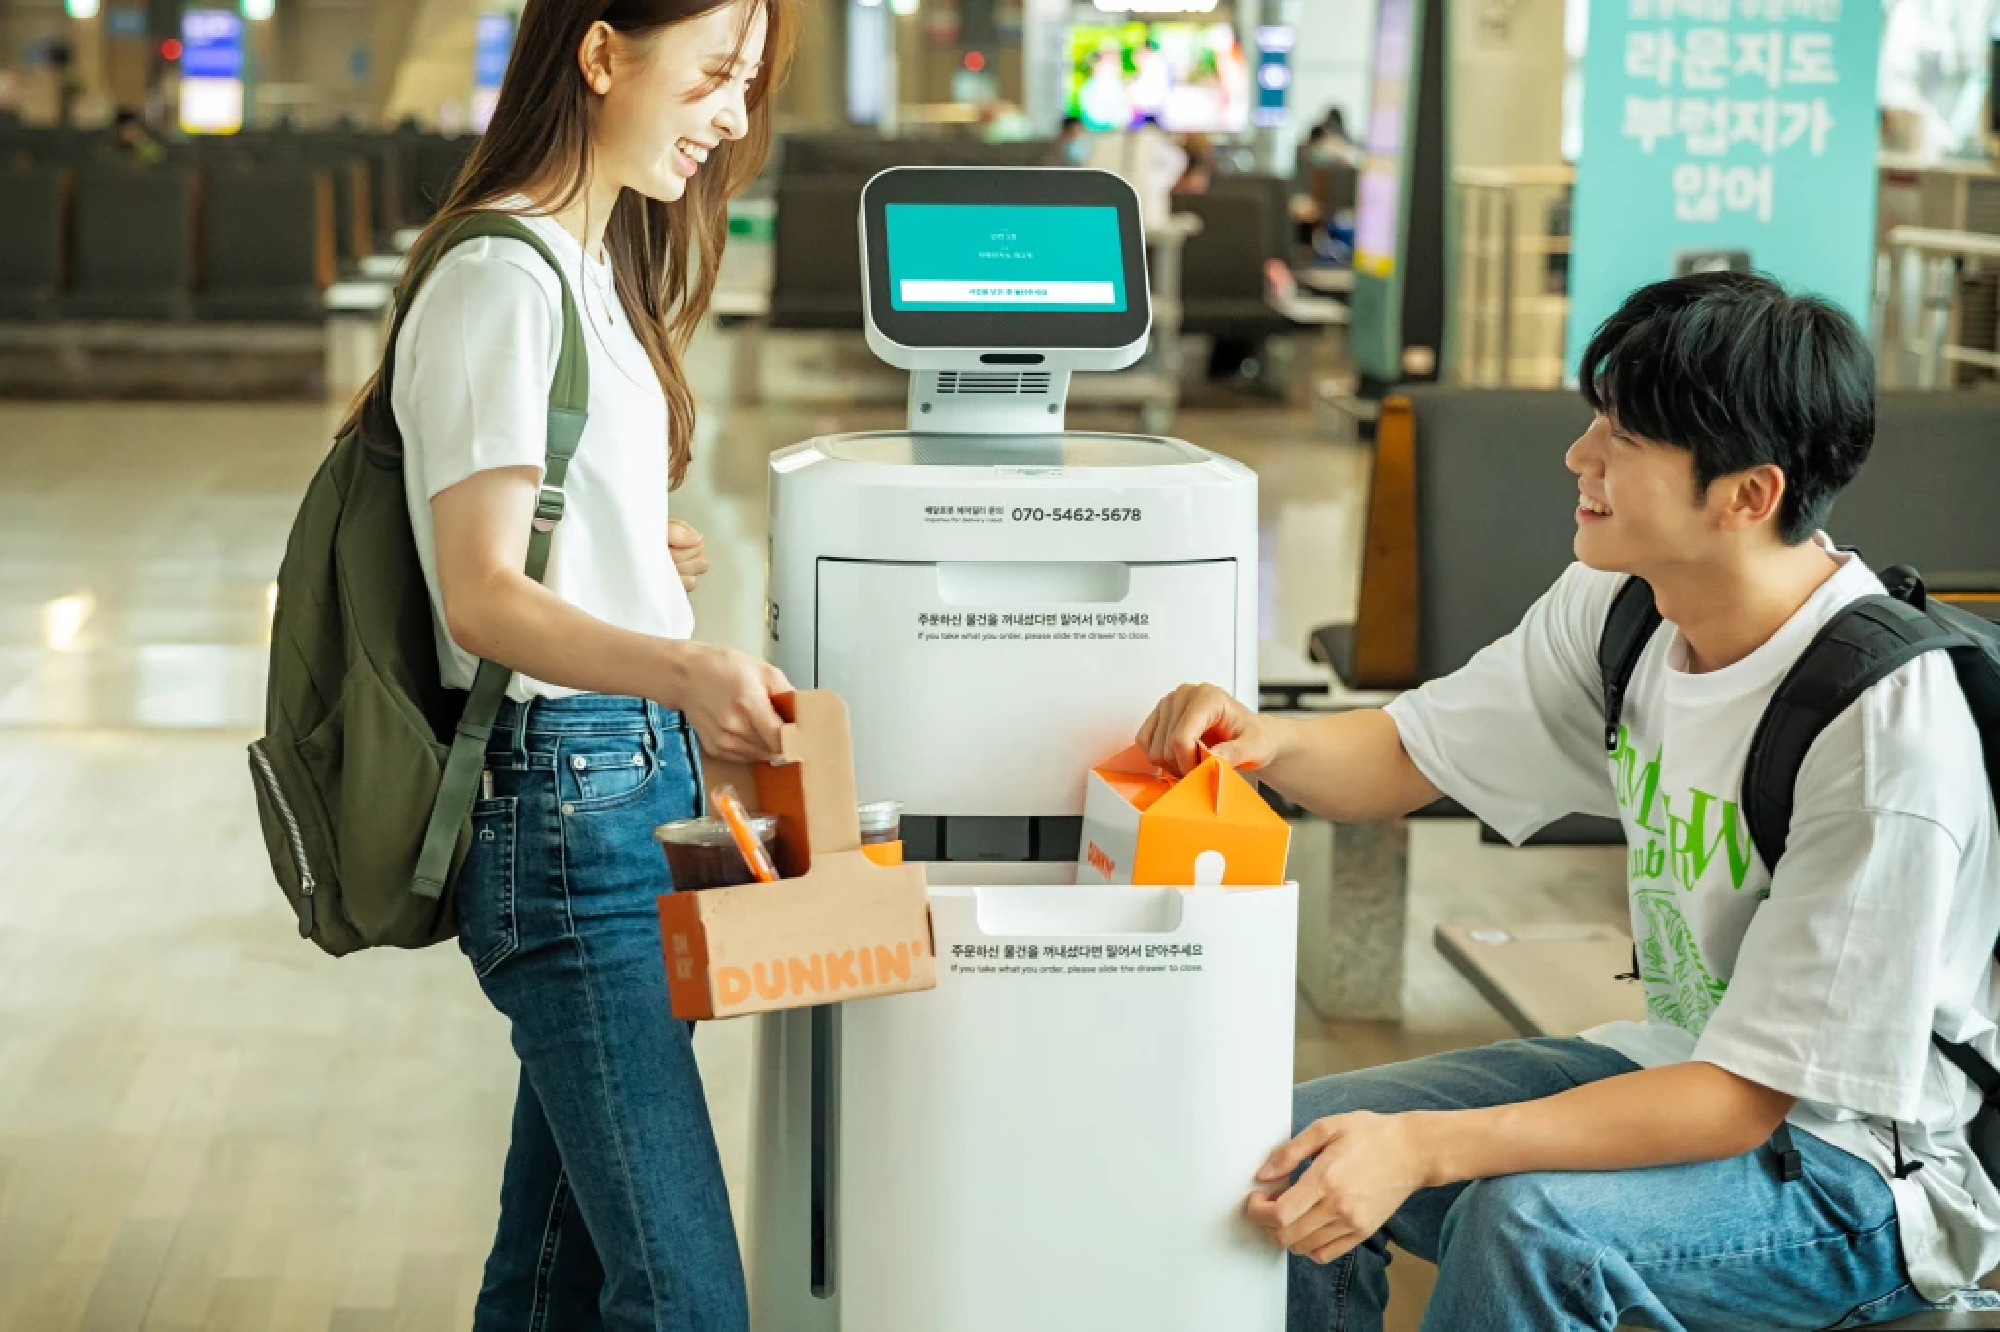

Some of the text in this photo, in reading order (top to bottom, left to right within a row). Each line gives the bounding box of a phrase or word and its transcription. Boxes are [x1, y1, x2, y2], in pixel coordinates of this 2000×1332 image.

[1623, 27, 1840, 90] 라운지도
[1011, 507, 1142, 522] 070-5462-5678
[918, 612, 962, 627] 주문하신
[965, 612, 999, 627] 물건을
[1060, 612, 1093, 627] 밀어서
[1096, 612, 1149, 627] 닫아주세요
[926, 632, 939, 642] you
[941, 632, 959, 640] take
[961, 632, 980, 640] what
[981, 632, 997, 642] you
[1025, 632, 1051, 642] please
[1053, 632, 1070, 640] slide
[1072, 632, 1086, 640] the
[1088, 631, 1115, 640] drawer
[951, 944, 1001, 959] 주문하신
[1004, 944, 1040, 959] 물건을
[1105, 943, 1142, 958] 밀어서
[1145, 943, 1204, 957] 닫아주세요
[716, 940, 923, 1007] DUNKIN'
[959, 966, 975, 975] you
[977, 965, 996, 974] take
[998, 965, 1020, 974] what
[1021, 966, 1037, 976] you
[1068, 965, 1096, 976] please
[1098, 965, 1117, 974] slide
[1119, 965, 1135, 974] the
[1137, 964, 1166, 973] drawer
